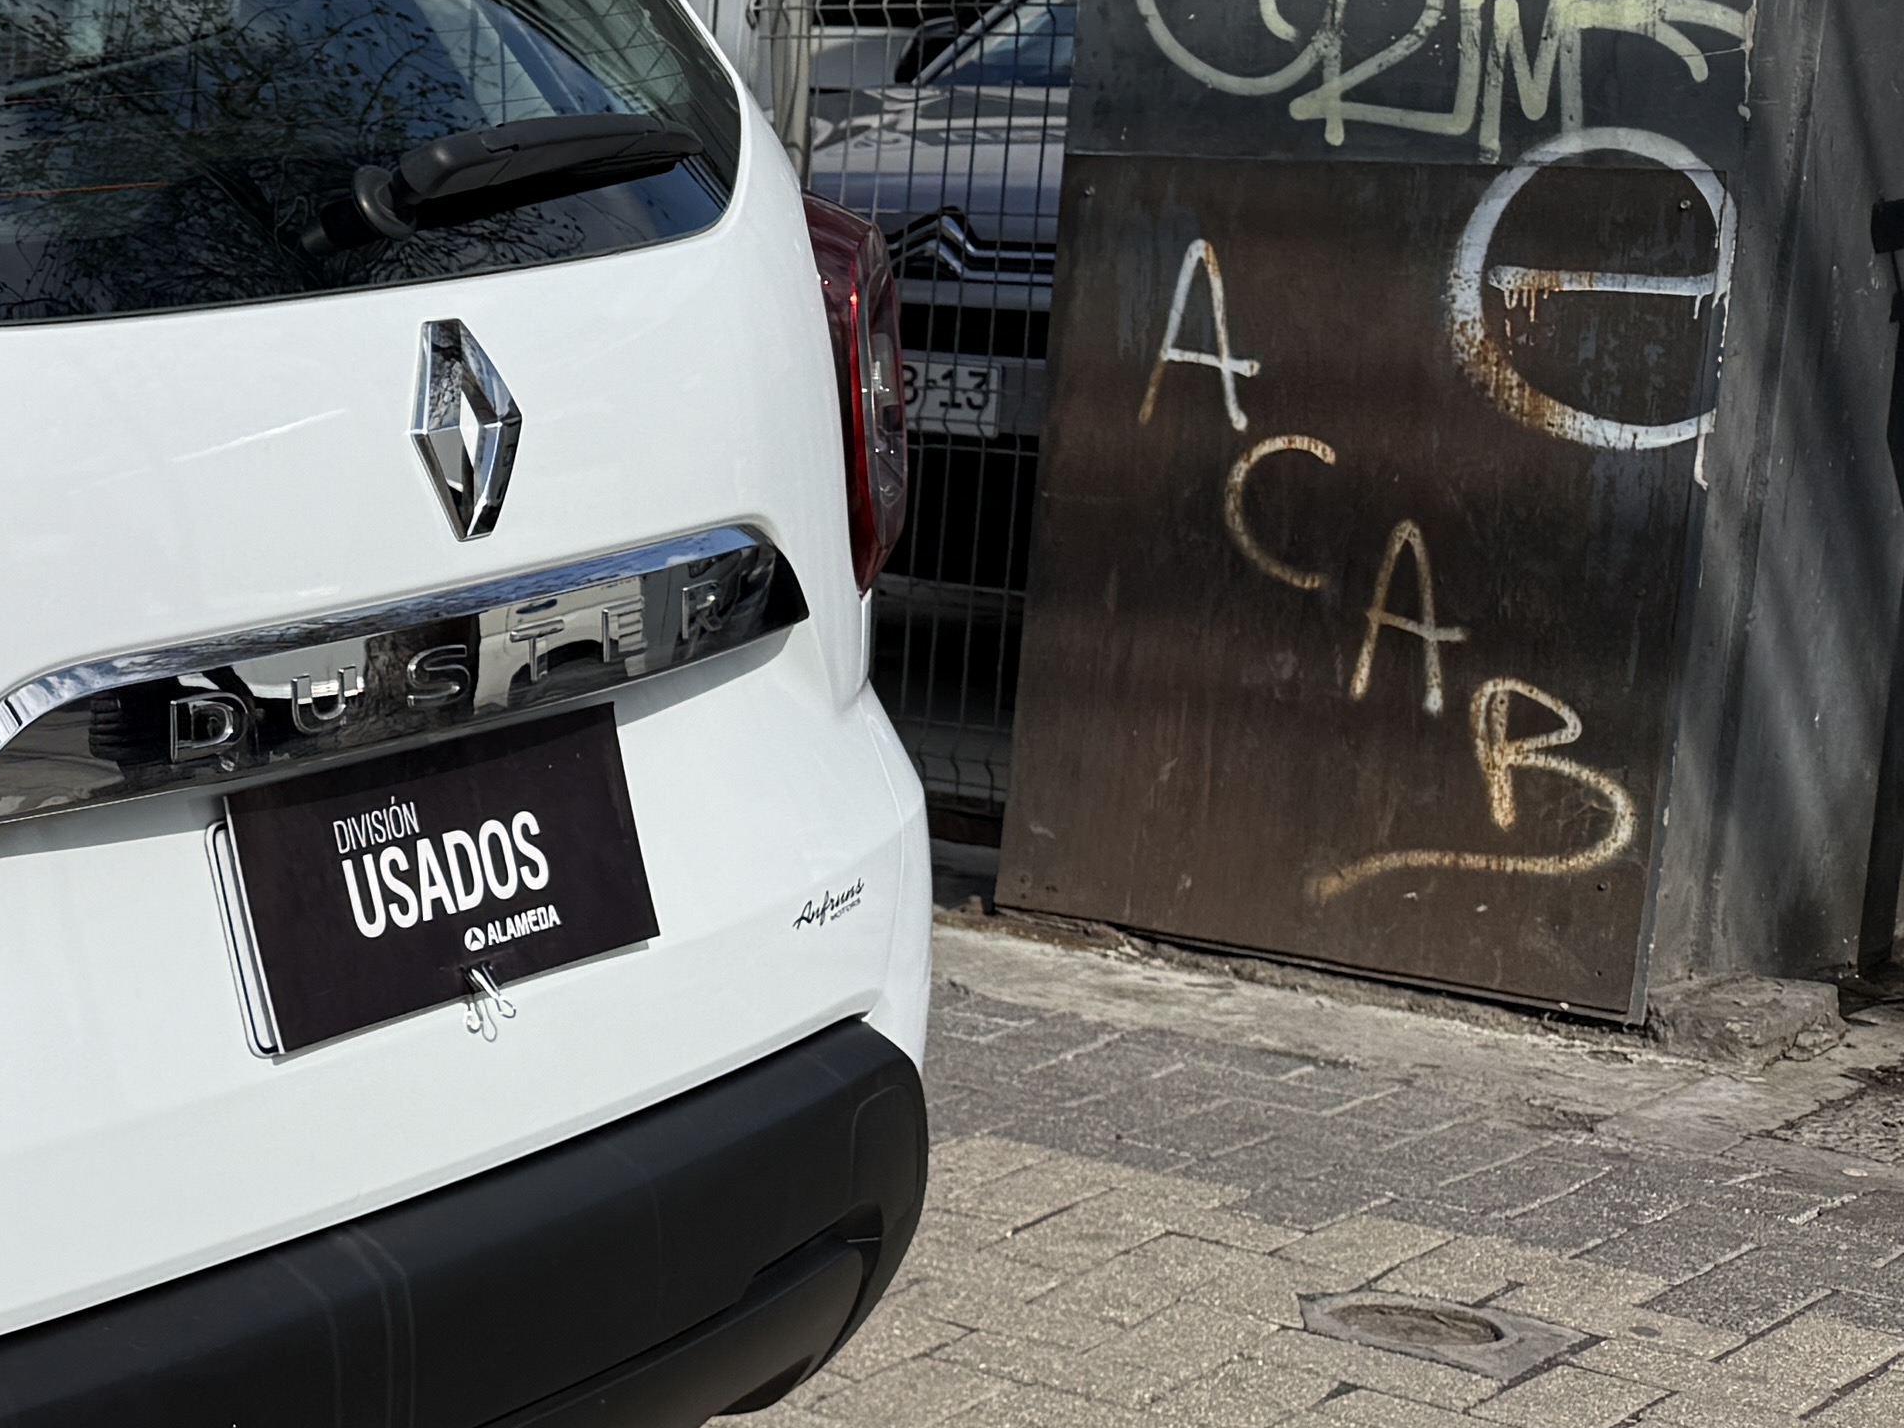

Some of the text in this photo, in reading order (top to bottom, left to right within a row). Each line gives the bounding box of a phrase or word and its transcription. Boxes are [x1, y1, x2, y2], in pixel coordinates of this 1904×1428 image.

[168, 578, 725, 764] DUSTER
[333, 796, 420, 855] DIVISIÓN
[342, 810, 550, 938] USADOS
[486, 904, 562, 948] ALAMEDA
